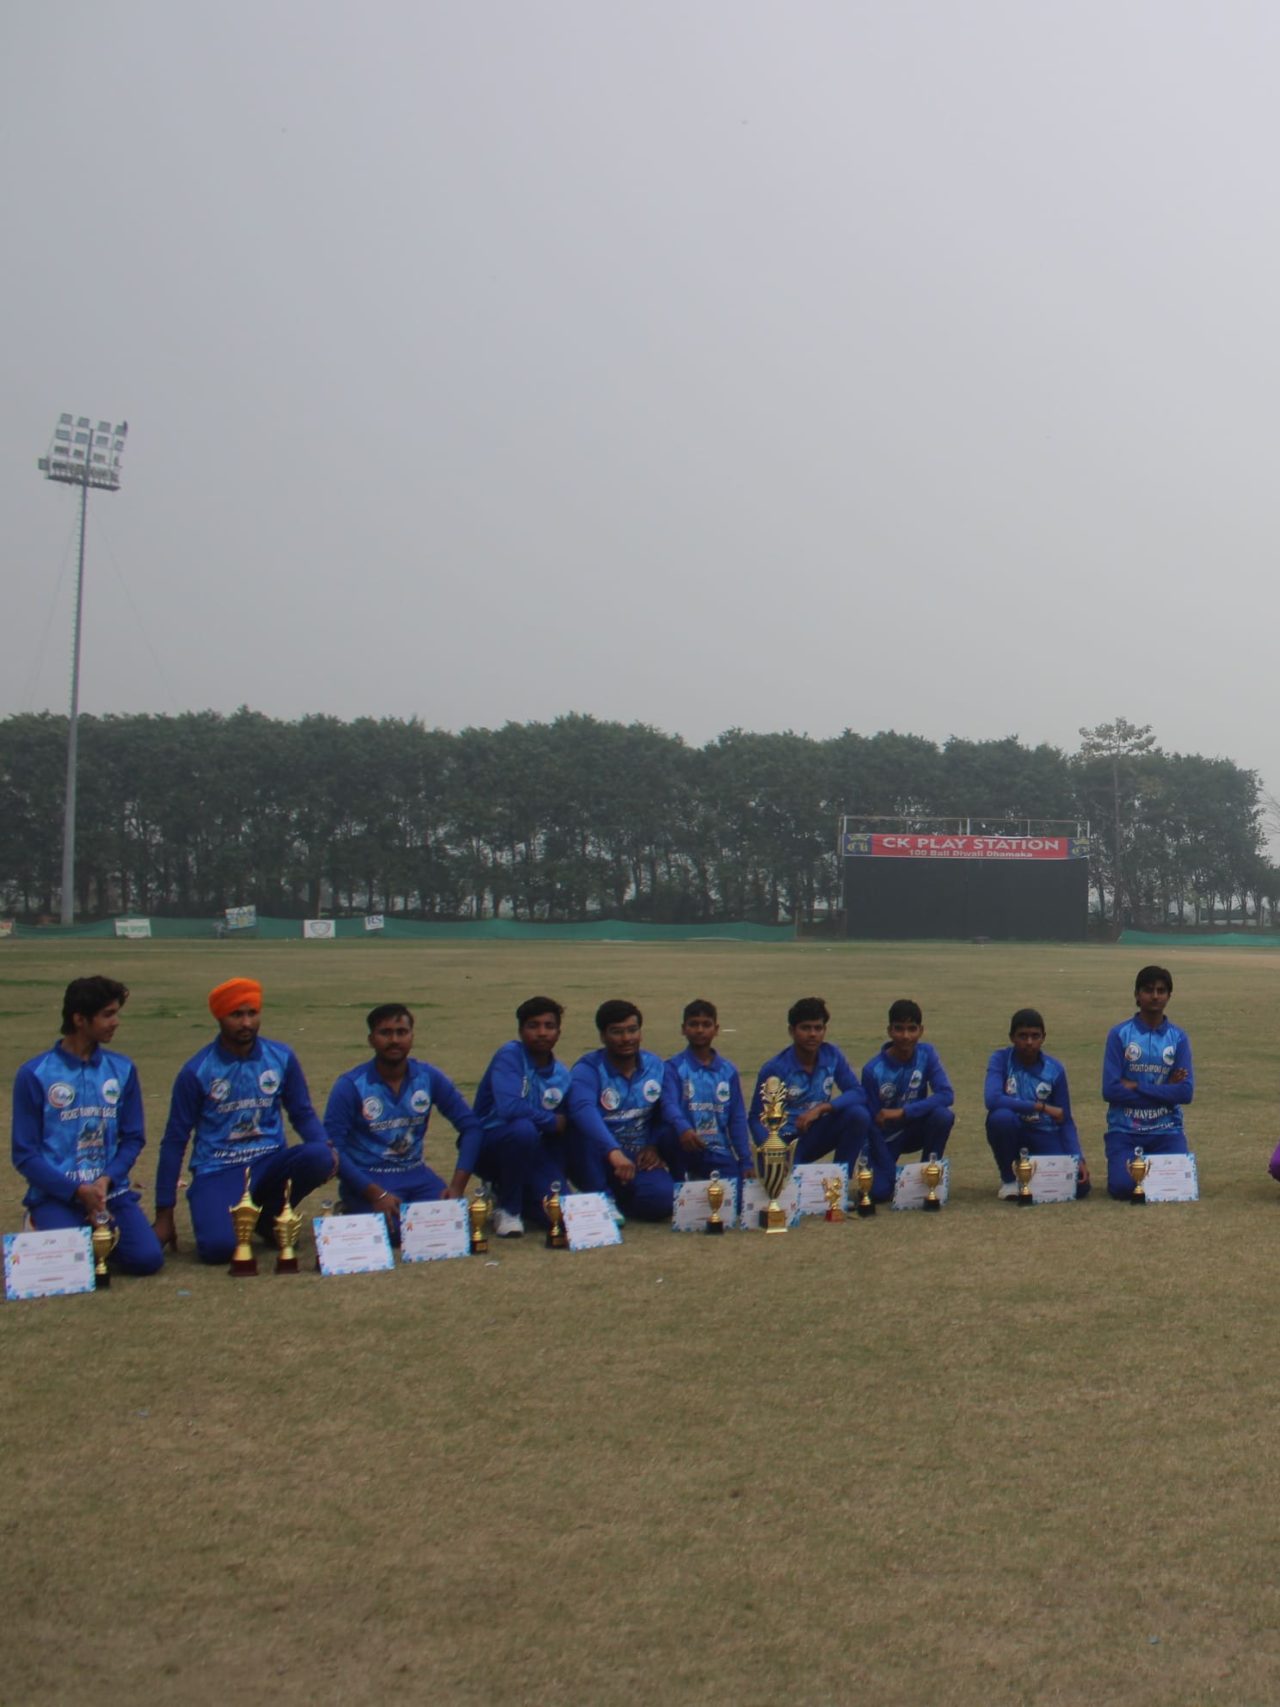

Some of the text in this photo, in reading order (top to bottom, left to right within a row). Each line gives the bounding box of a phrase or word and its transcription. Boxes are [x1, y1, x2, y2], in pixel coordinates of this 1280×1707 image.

[882, 838, 910, 849] CK
[917, 838, 966, 850] PLAY
[973, 839, 1060, 851] STATION
[910, 849, 1033, 858] 100 Ball Diwali Dhamaka
